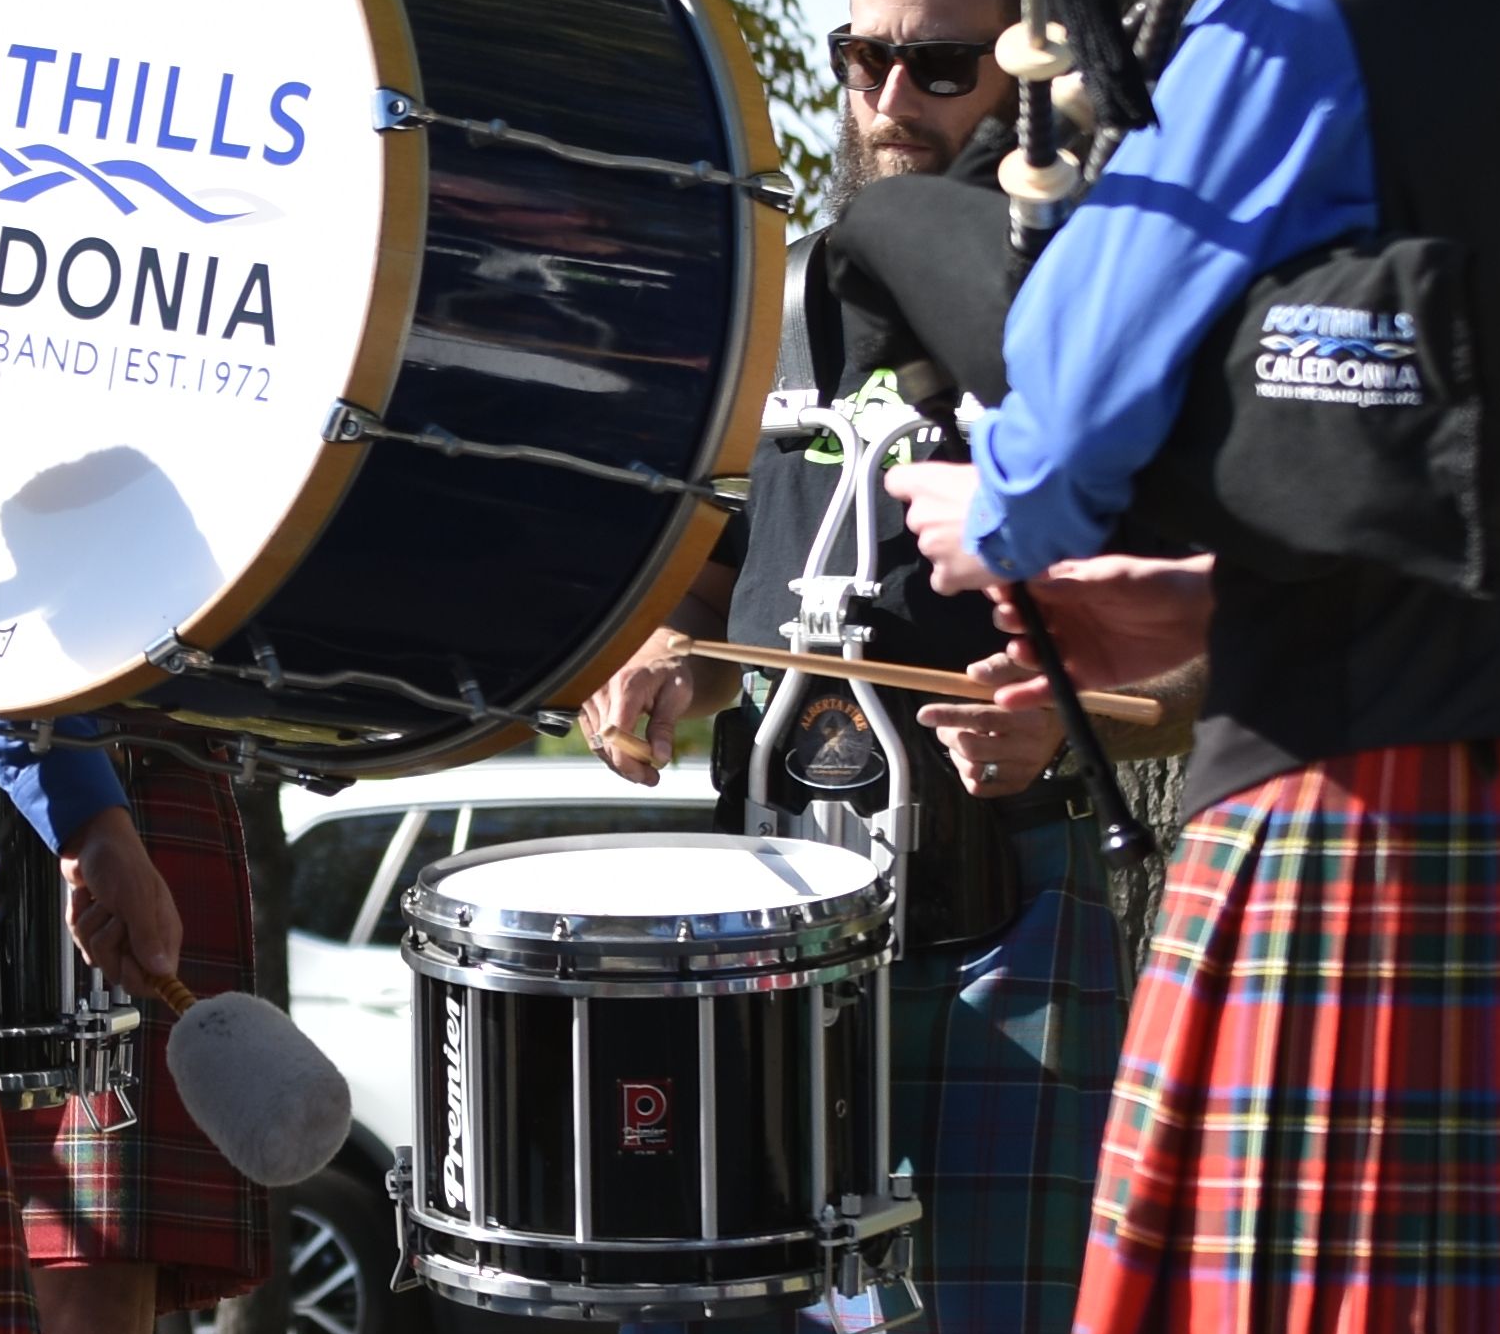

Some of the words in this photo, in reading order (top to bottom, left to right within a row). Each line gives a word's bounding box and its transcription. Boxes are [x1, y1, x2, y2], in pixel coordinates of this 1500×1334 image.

[1261, 303, 1416, 340] FOOTHILLS
[1255, 352, 1421, 390] CALEDONIA
[801, 698, 843, 732] ALBERTA
[844, 703, 869, 732] FIRE
[443, 996, 464, 1209] Premier
